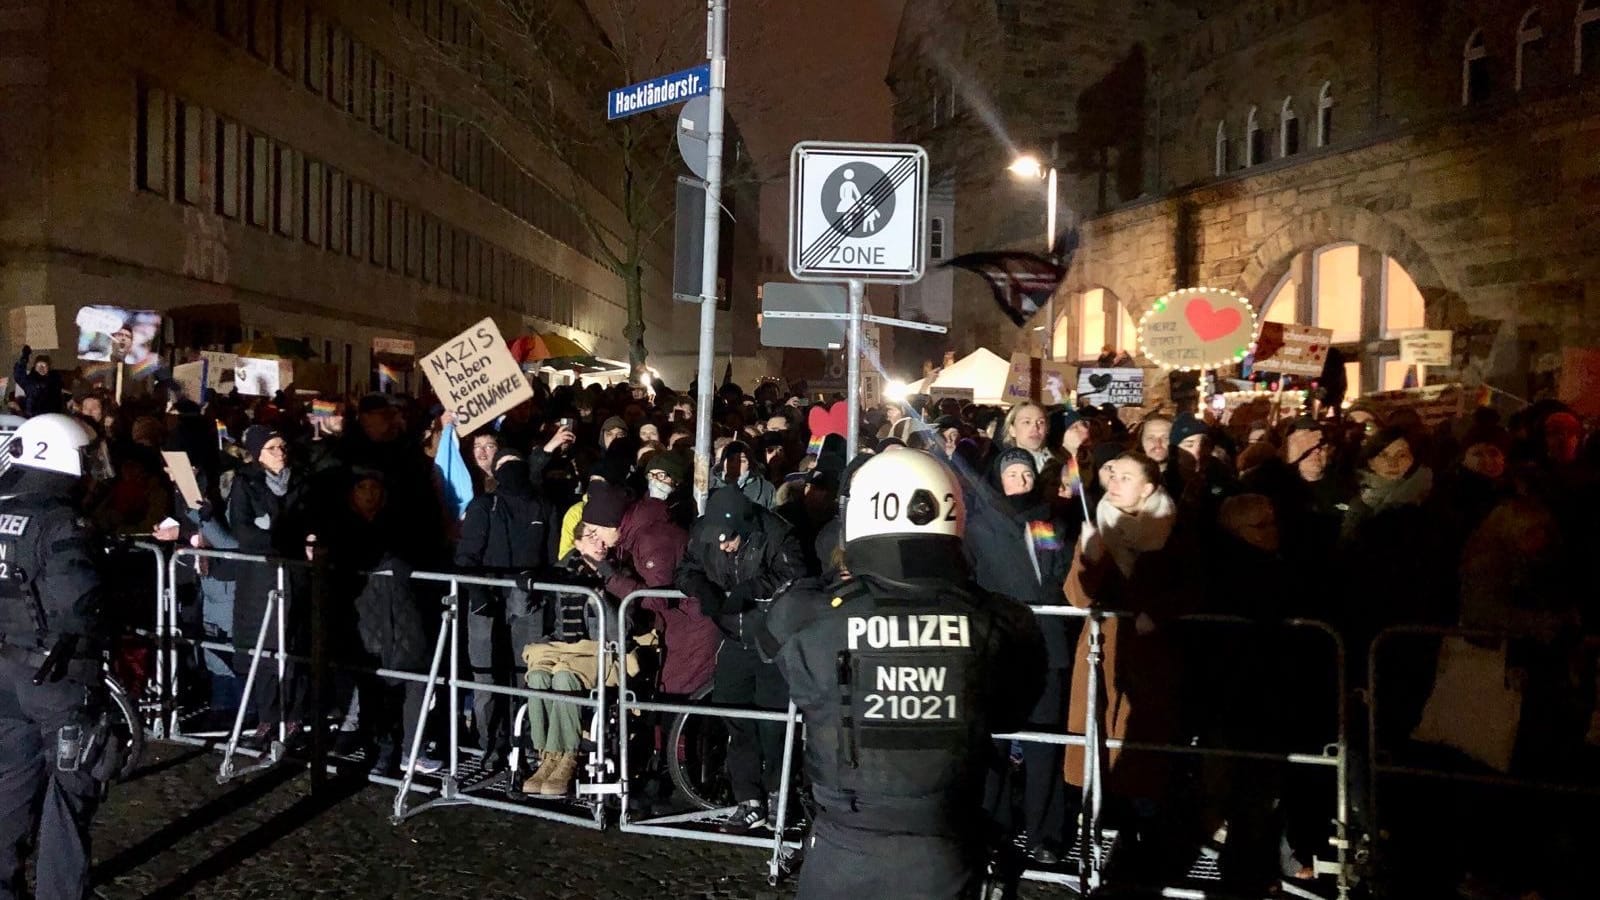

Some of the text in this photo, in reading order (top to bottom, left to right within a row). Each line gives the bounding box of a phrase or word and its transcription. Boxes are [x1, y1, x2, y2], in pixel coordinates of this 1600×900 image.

[615, 73, 703, 114] Hackländerstr.
[829, 246, 886, 265] ZONE
[430, 327, 495, 376] NAZIS
[444, 355, 492, 388] haben
[449, 372, 490, 403] keine
[457, 373, 522, 425] SCHWÄNZE
[34, 441, 48, 460] 2
[870, 491, 957, 521] 10 2
[847, 615, 971, 650] POLIZEI
[876, 666, 946, 692] NRW
[864, 694, 956, 720] 21021
